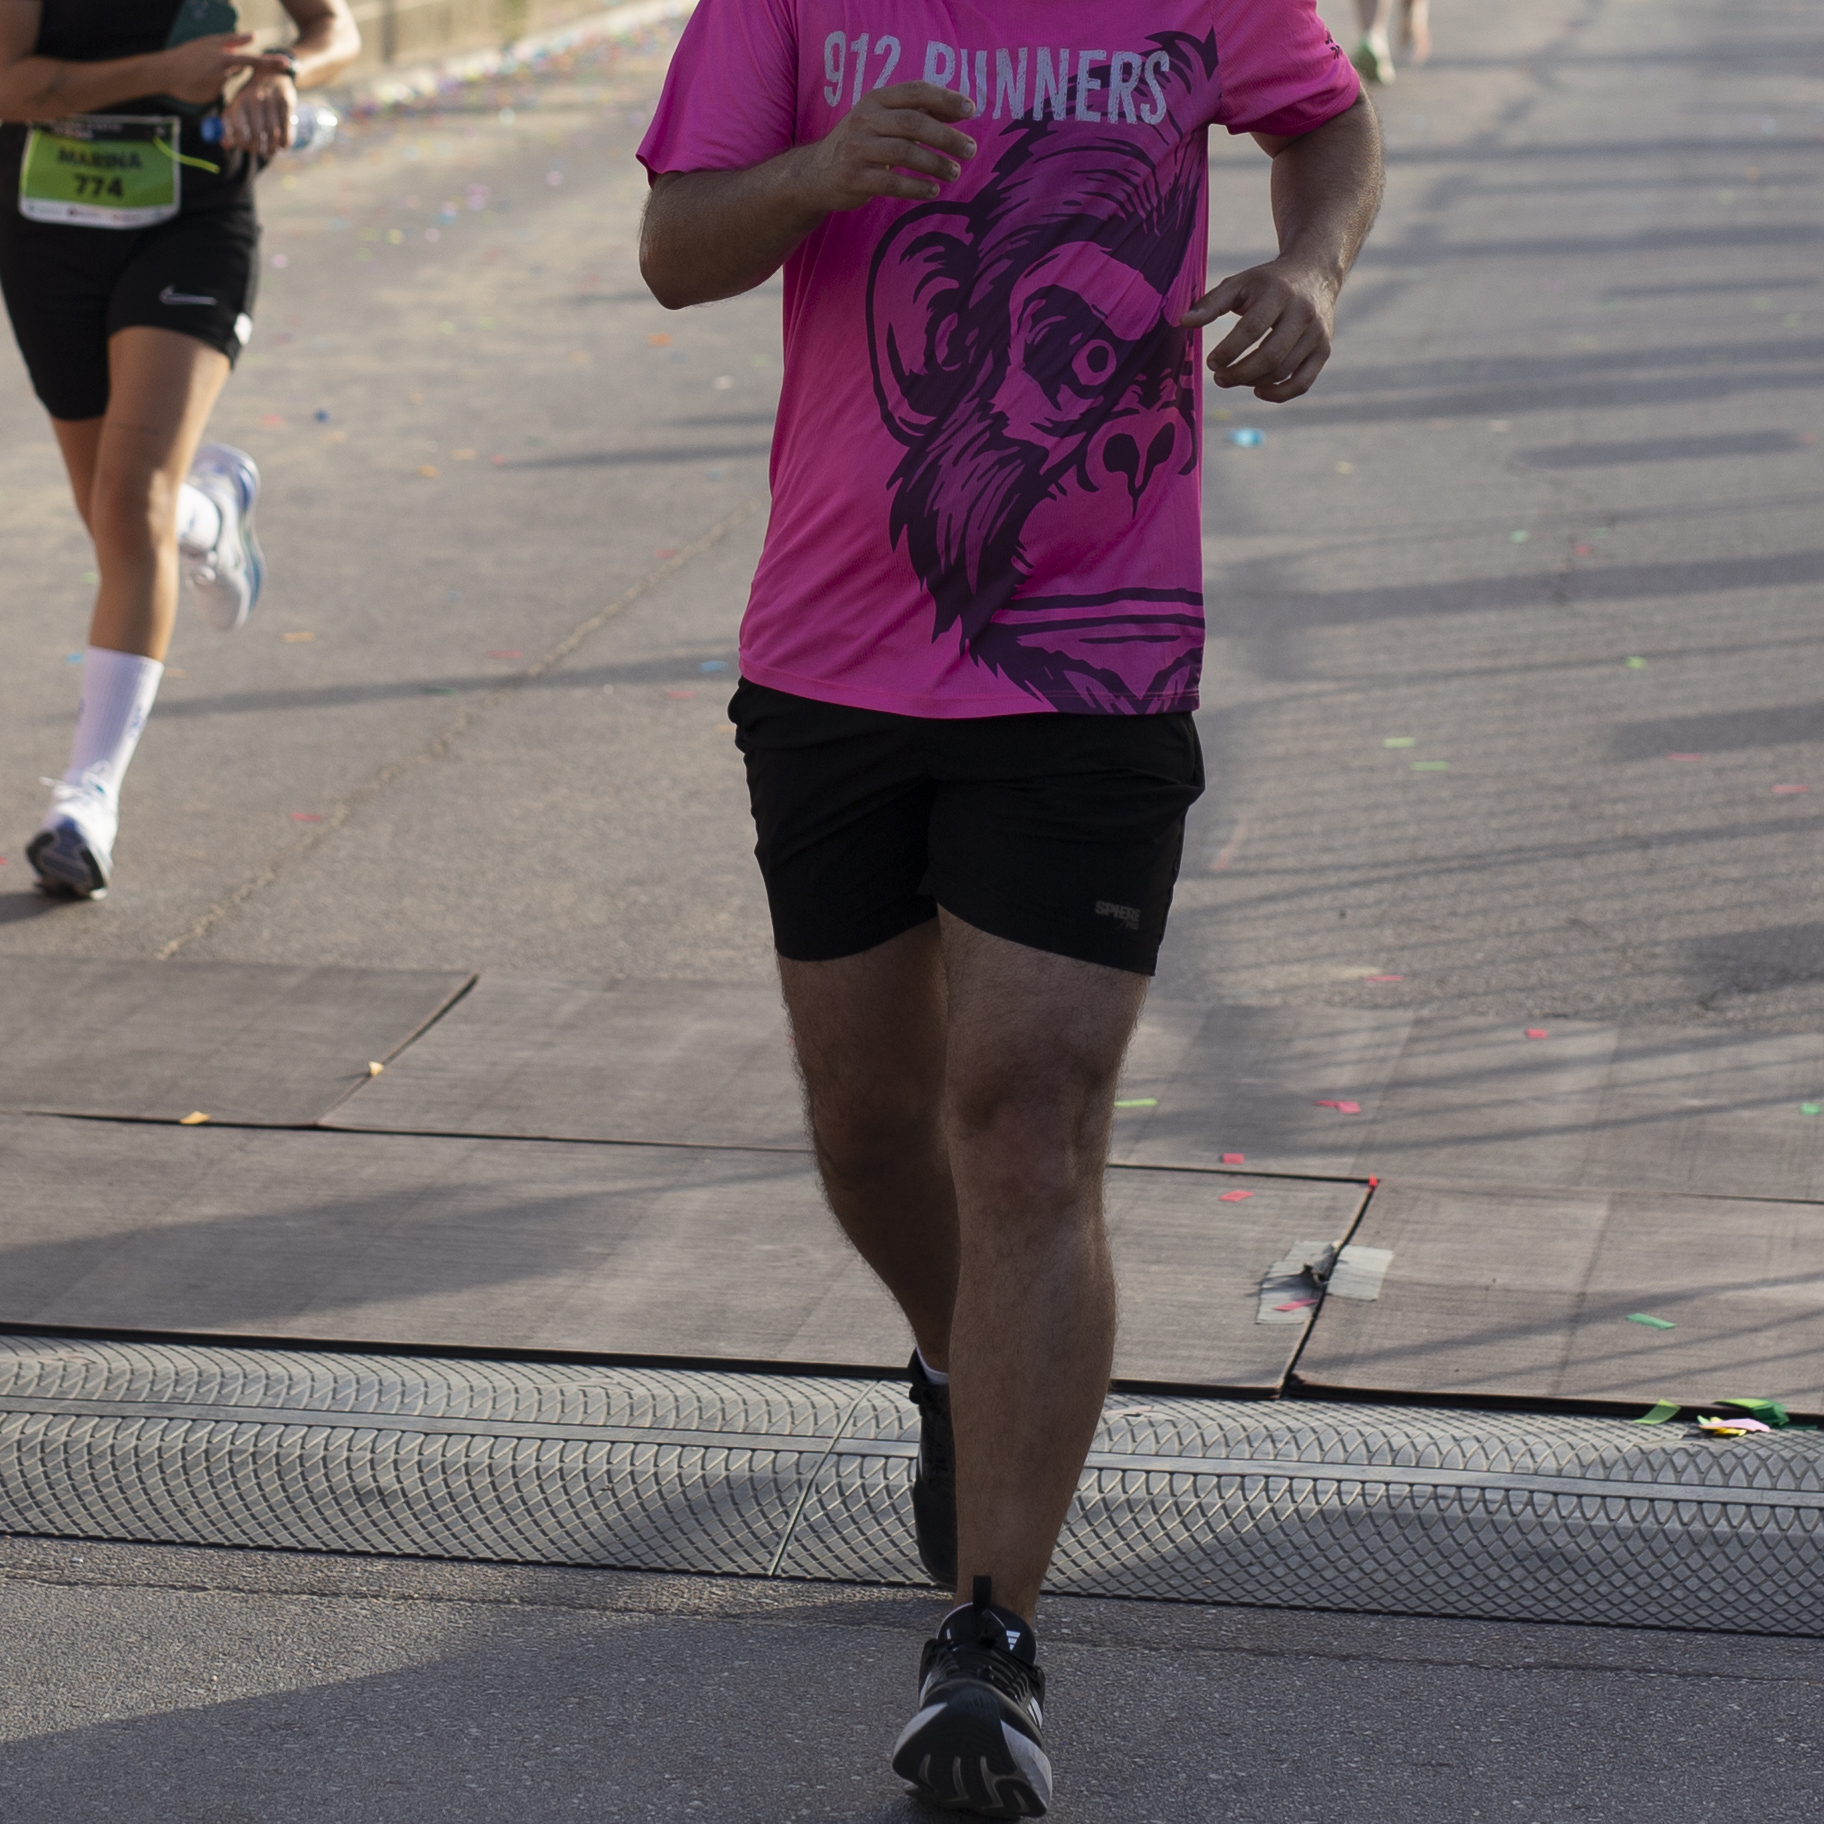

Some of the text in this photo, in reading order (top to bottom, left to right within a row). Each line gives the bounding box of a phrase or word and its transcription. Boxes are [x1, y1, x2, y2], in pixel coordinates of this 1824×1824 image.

[823, 30, 1170, 126] 912 RUNNERS
[74, 173, 123, 198] 774
[1095, 900, 1141, 922] SPHERE
